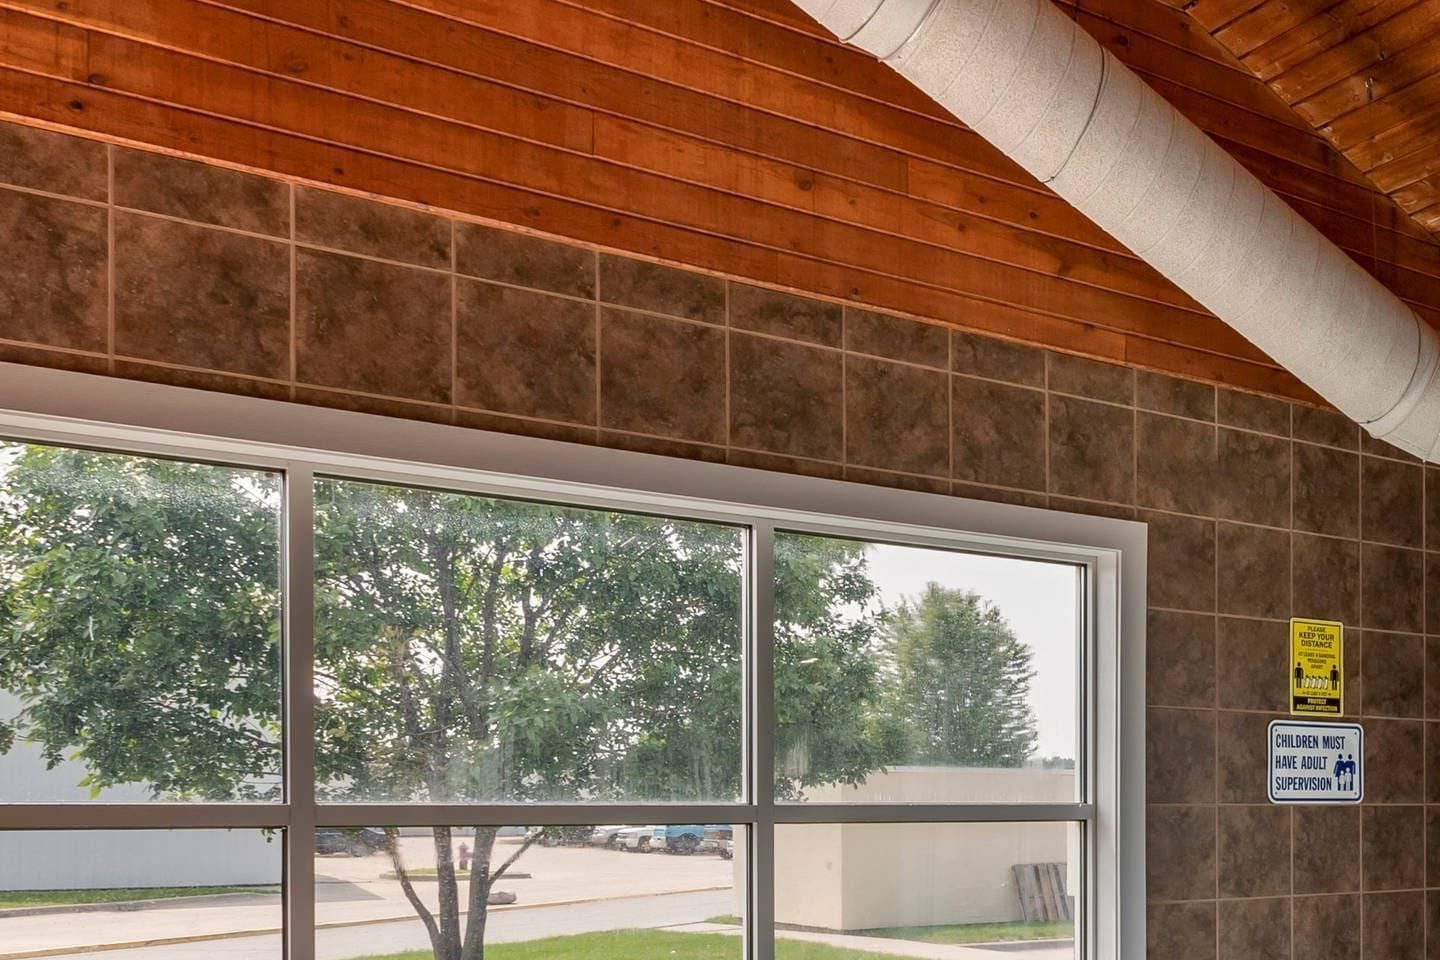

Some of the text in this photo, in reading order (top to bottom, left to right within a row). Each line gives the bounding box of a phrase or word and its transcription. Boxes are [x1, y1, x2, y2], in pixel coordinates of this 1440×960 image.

[1301, 639, 1332, 648] DISTANCE
[1317, 633, 1335, 641] YOUR
[1275, 734, 1346, 750] CHILDREN MUST
[1275, 755, 1328, 770] HAVE ADULT
[1275, 776, 1332, 791] SUPERVISION
